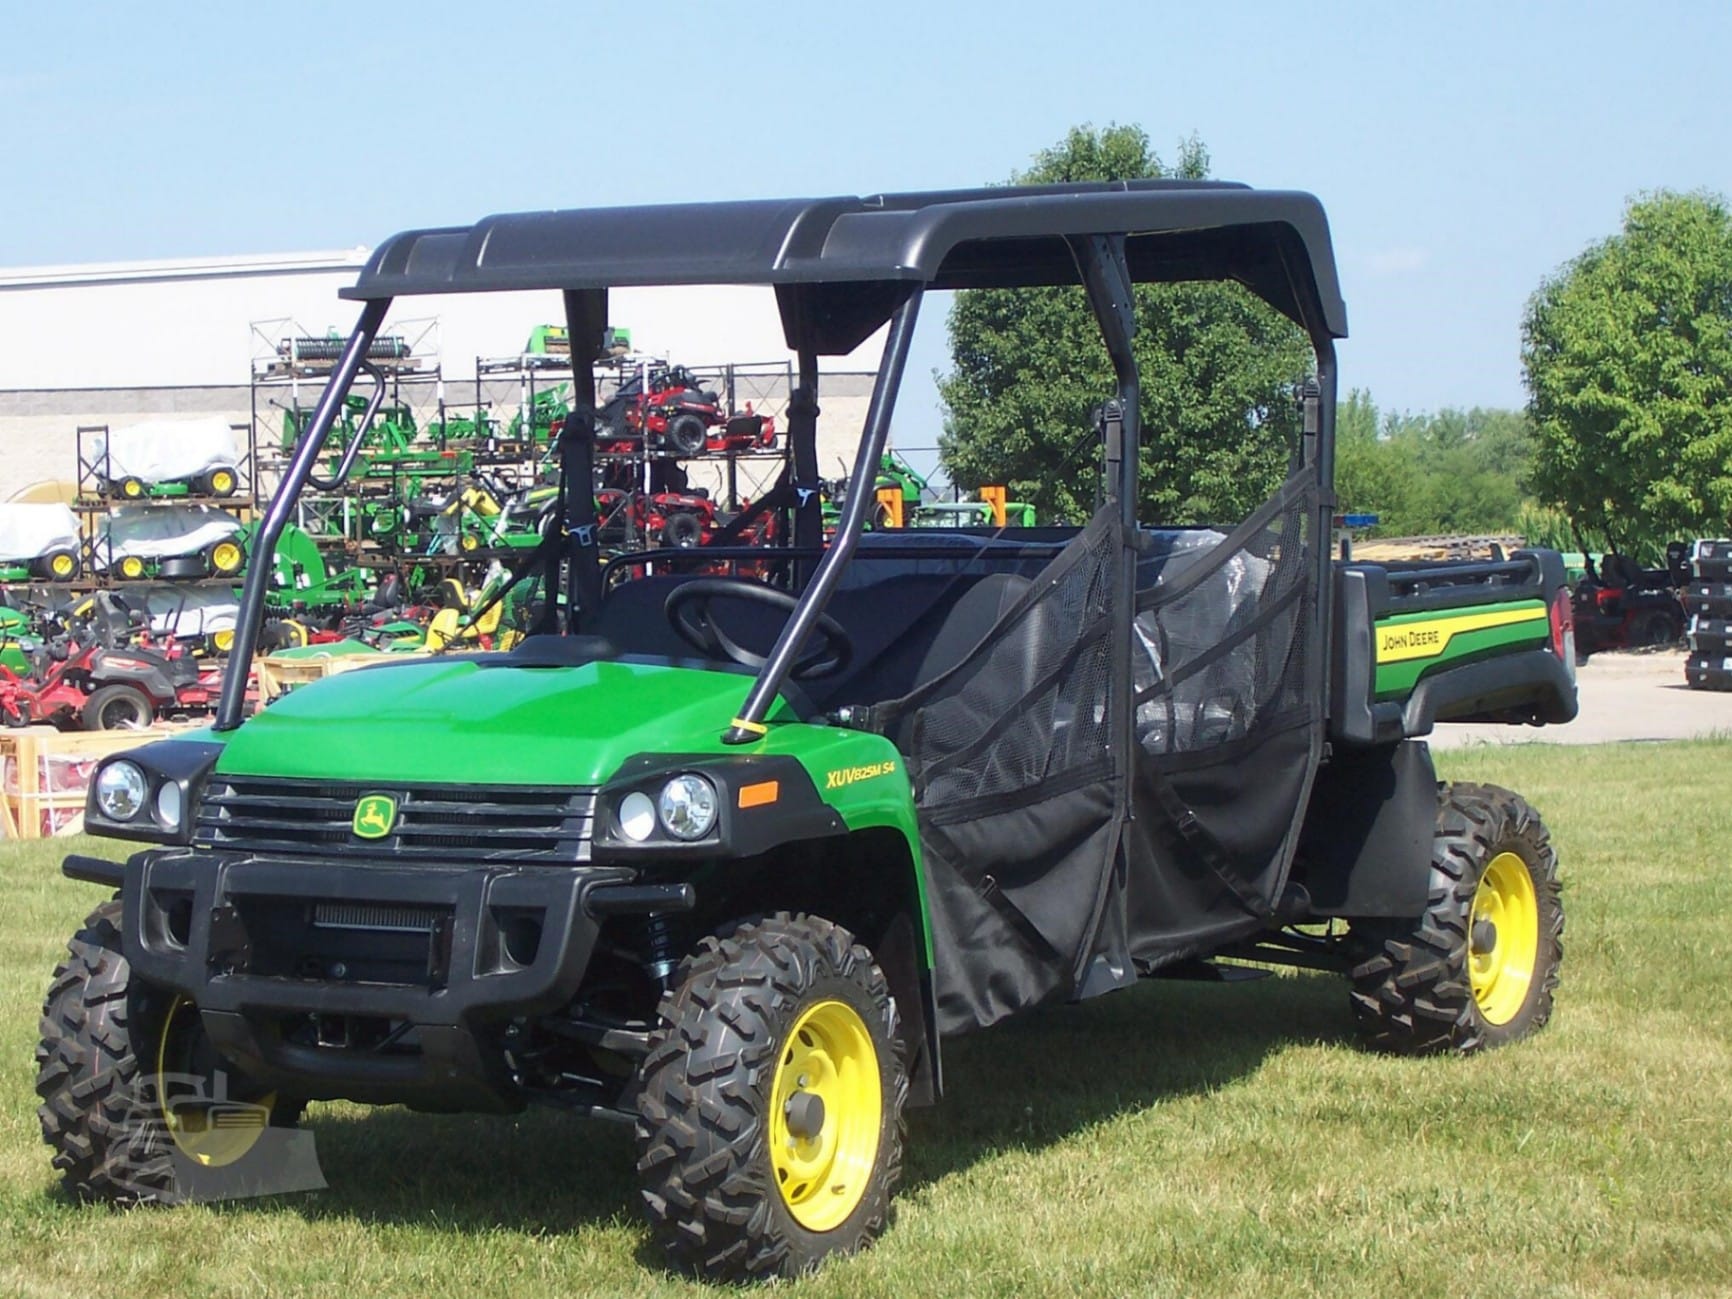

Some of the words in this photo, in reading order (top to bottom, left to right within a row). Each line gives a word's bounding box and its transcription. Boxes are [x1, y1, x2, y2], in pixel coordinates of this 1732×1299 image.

[1383, 634, 1408, 651] JOHN
[1409, 631, 1439, 647] DEERE
[826, 764, 881, 789] XUV825M
[883, 761, 896, 774] S4
